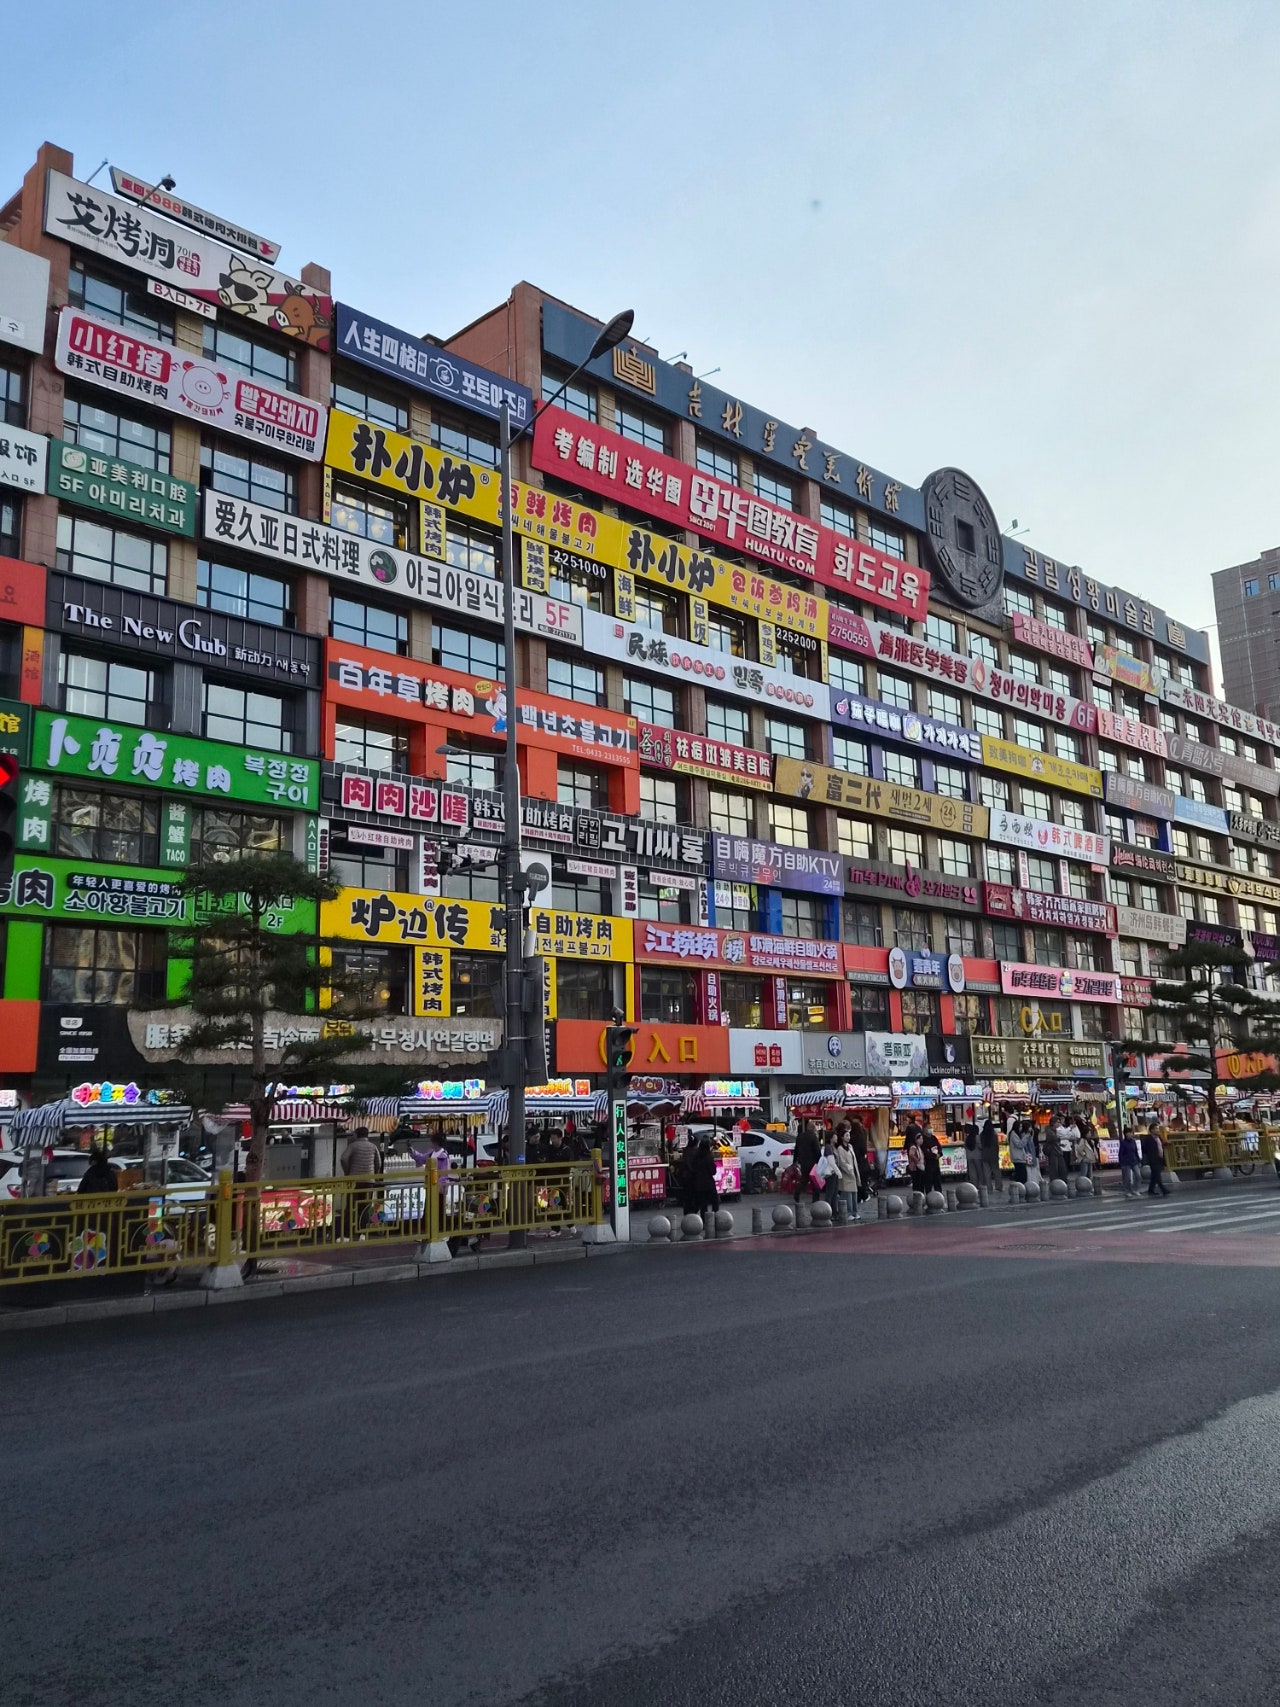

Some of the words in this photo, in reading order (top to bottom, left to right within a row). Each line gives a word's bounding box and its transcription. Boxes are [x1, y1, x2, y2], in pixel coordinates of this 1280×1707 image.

[56, 191, 175, 269] 艾烤洞
[153, 282, 187, 307] B入口
[196, 299, 211, 316] 7F
[74, 324, 167, 381] 小红猪
[345, 320, 416, 369] 人生四格
[67, 351, 169, 401] 韩式自助烤肉
[240, 384, 316, 435] 빨간돼지
[89, 457, 187, 504] 亚美利口腔
[351, 423, 476, 506] 朴小炉
[555, 427, 618, 479] 考编制
[625, 456, 682, 506] 选华图
[59, 474, 84, 493] 5F
[89, 482, 186, 529] 아미리치과
[719, 486, 819, 562] 华图教育
[215, 498, 360, 576] 爱久亚日式料理
[424, 505, 442, 556] 韩式烤肉
[627, 529, 715, 593] 朴小炉
[832, 543, 920, 609] 화도교육
[407, 558, 533, 627] 아크아일식리
[545, 602, 570, 628] 5F
[617, 575, 632, 617] 海鲜
[1023, 547, 1155, 636] 길림성황미술관
[64, 603, 113, 629] The
[123, 616, 173, 644] New
[178, 619, 227, 656] Club
[693, 603, 706, 642] 包饭
[830, 624, 869, 648] 2750555
[235, 647, 273, 667] 新动力
[627, 632, 669, 669] 民族
[338, 657, 474, 716] 百年草烤肉
[732, 665, 765, 693] 민족
[989, 673, 1066, 720] 청아의학미용
[521, 703, 631, 753] 백년초불고기
[1076, 706, 1094, 729] 6F
[243, 754, 309, 784] 복정정
[265, 781, 309, 804] 구이
[826, 774, 881, 810] 富二代
[23, 778, 50, 843] 烤肉
[167, 802, 186, 844] 酱蟹
[344, 777, 467, 824] 肉肉沙隆
[473, 797, 573, 832] 韩式助烤肉
[166, 848, 186, 863] TACO
[601, 819, 703, 864] 고기싸롱
[717, 837, 839, 877] 自嗨魔方自助KTV
[65, 890, 185, 920] 소아향불고기
[734, 884, 747, 893] KTV
[267, 914, 283, 927] 2F
[352, 894, 469, 945] 炉边传
[536, 911, 612, 940] 自助烤肉
[645, 924, 718, 959] 江捞捞
[423, 952, 443, 1012] 韩式烤肉
[707, 973, 718, 1022] 自助火锅
[145, 1023, 320, 1050] 服务吉冷面
[1021, 1006, 1062, 1033] C入口
[647, 1033, 698, 1063] 入口
[615, 1103, 626, 1206] 行人安全通行
